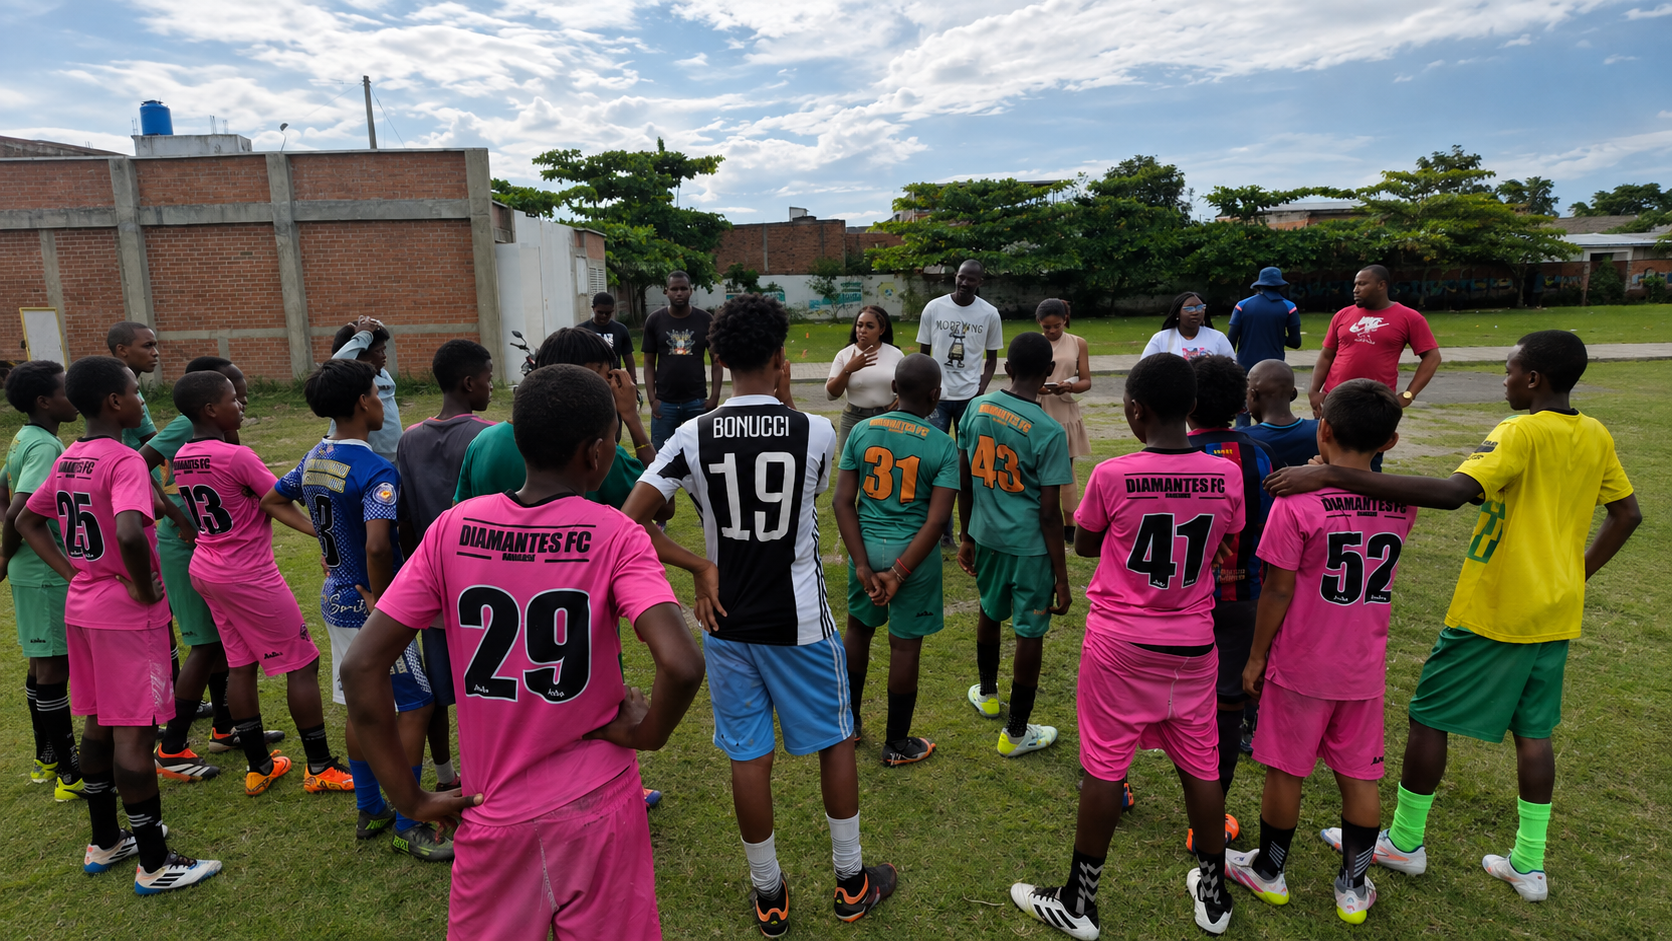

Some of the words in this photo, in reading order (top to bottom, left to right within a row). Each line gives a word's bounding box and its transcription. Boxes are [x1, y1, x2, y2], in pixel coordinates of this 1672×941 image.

[713, 415, 789, 438] BONUCCI
[862, 446, 921, 504] 31
[971, 434, 1025, 493] 43
[1125, 478, 1209, 493] DIAMANTES
[1211, 478, 1225, 493] FC
[56, 490, 105, 561] 25
[178, 484, 233, 534] 13
[708, 451, 796, 542] 19
[1321, 497, 1393, 513] DIAMANTES
[459, 525, 561, 554] DIAMANTES
[564, 531, 592, 553] FC
[1126, 513, 1215, 589] 41
[1319, 531, 1403, 606] 52
[458, 584, 592, 705] 29
